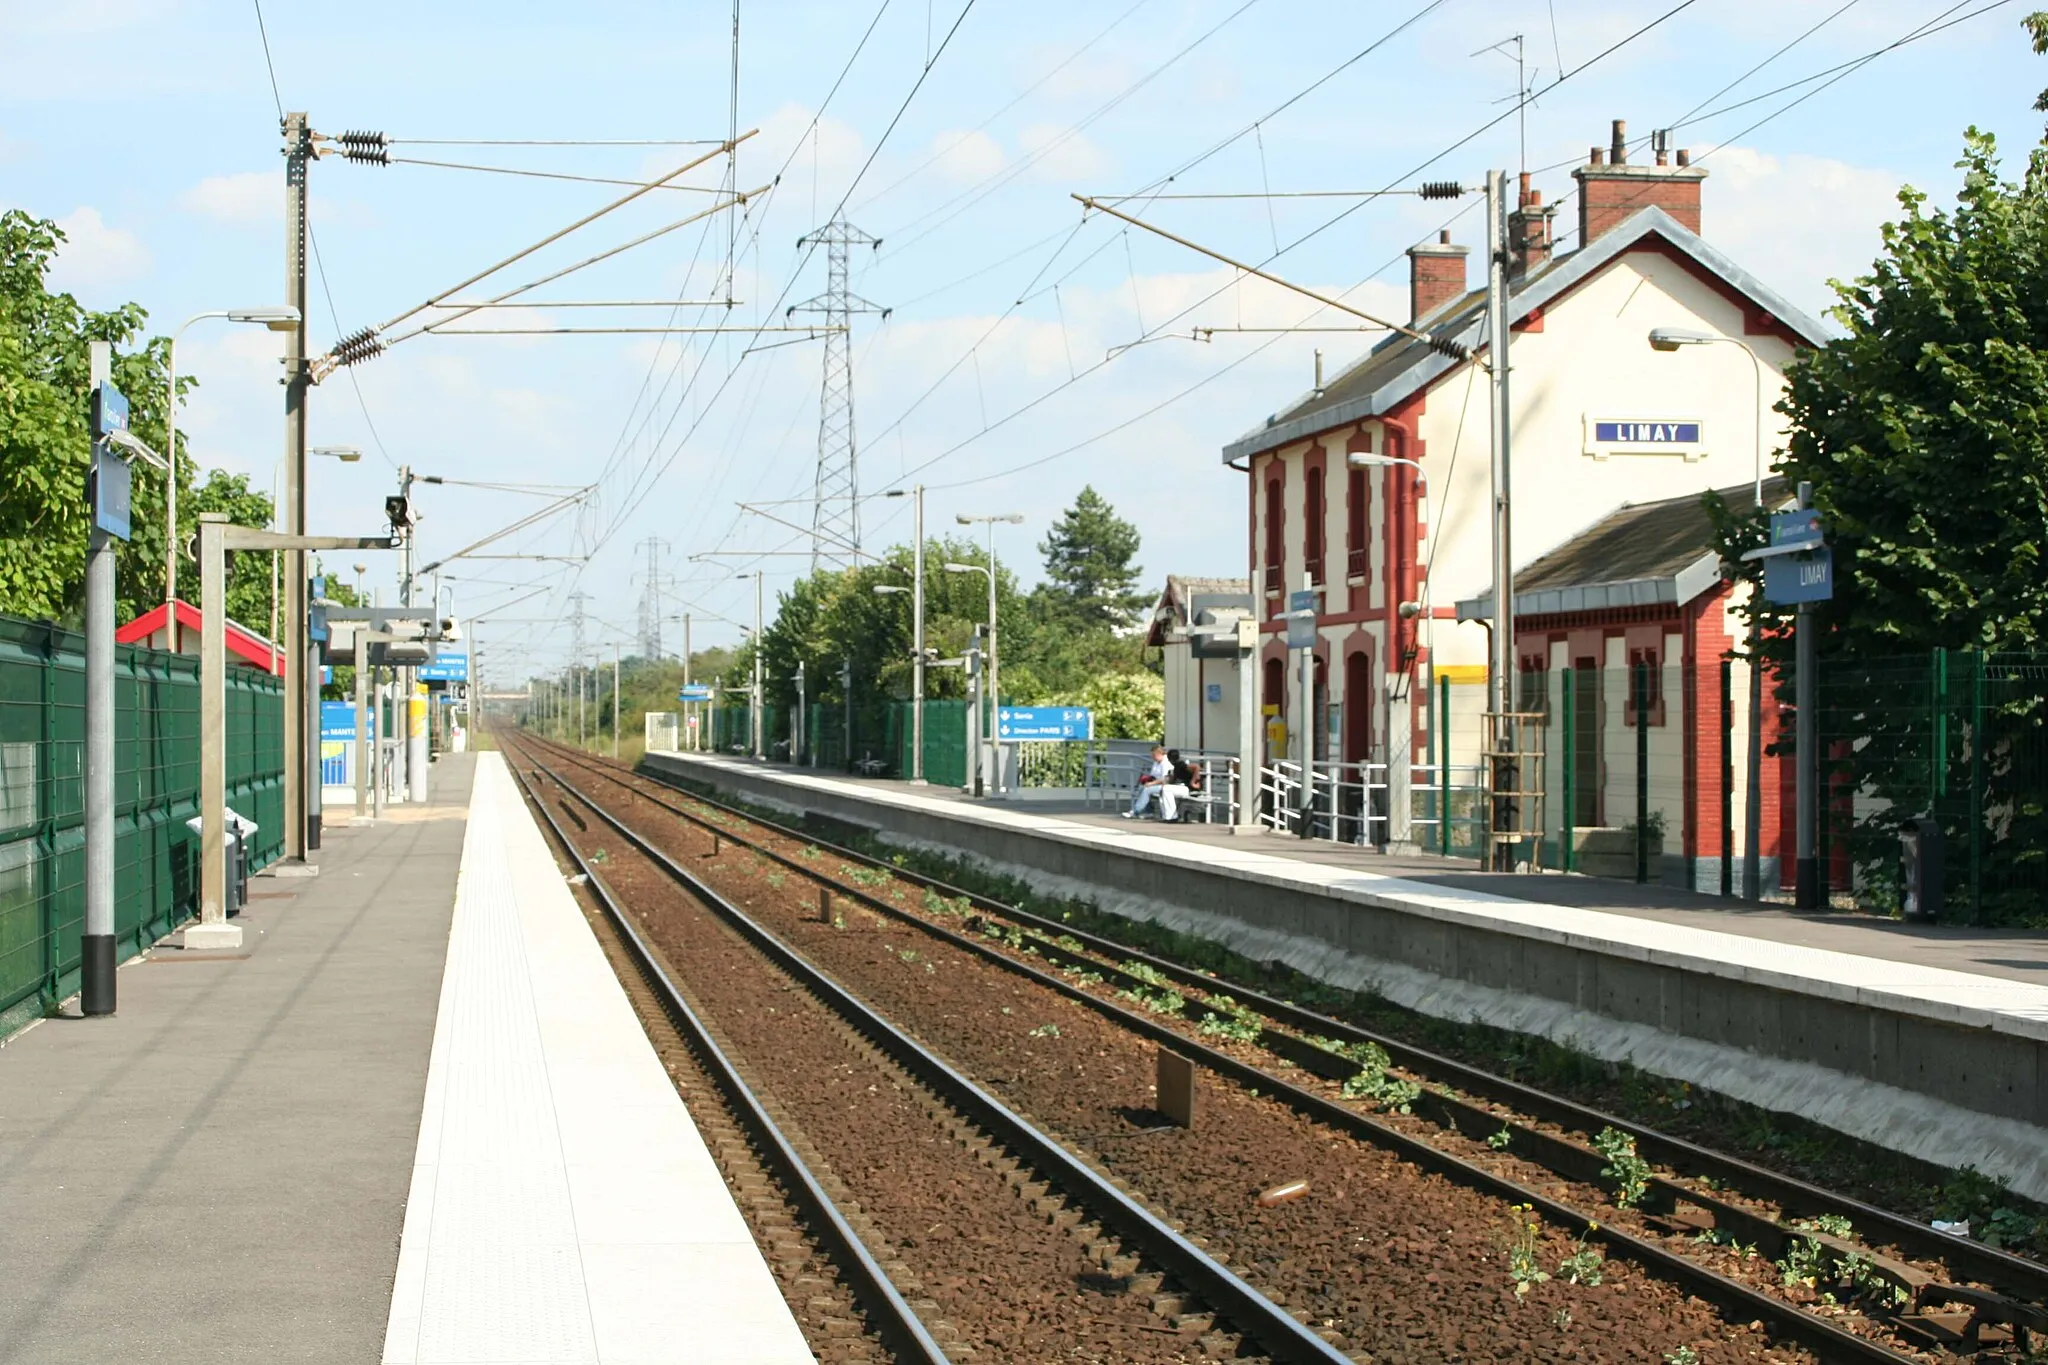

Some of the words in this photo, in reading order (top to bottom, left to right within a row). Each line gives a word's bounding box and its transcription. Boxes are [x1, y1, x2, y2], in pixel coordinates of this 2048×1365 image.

[1617, 424, 1678, 441] LIMAY
[1800, 563, 1827, 587] LIMAY
[330, 728, 357, 736] MANTE
